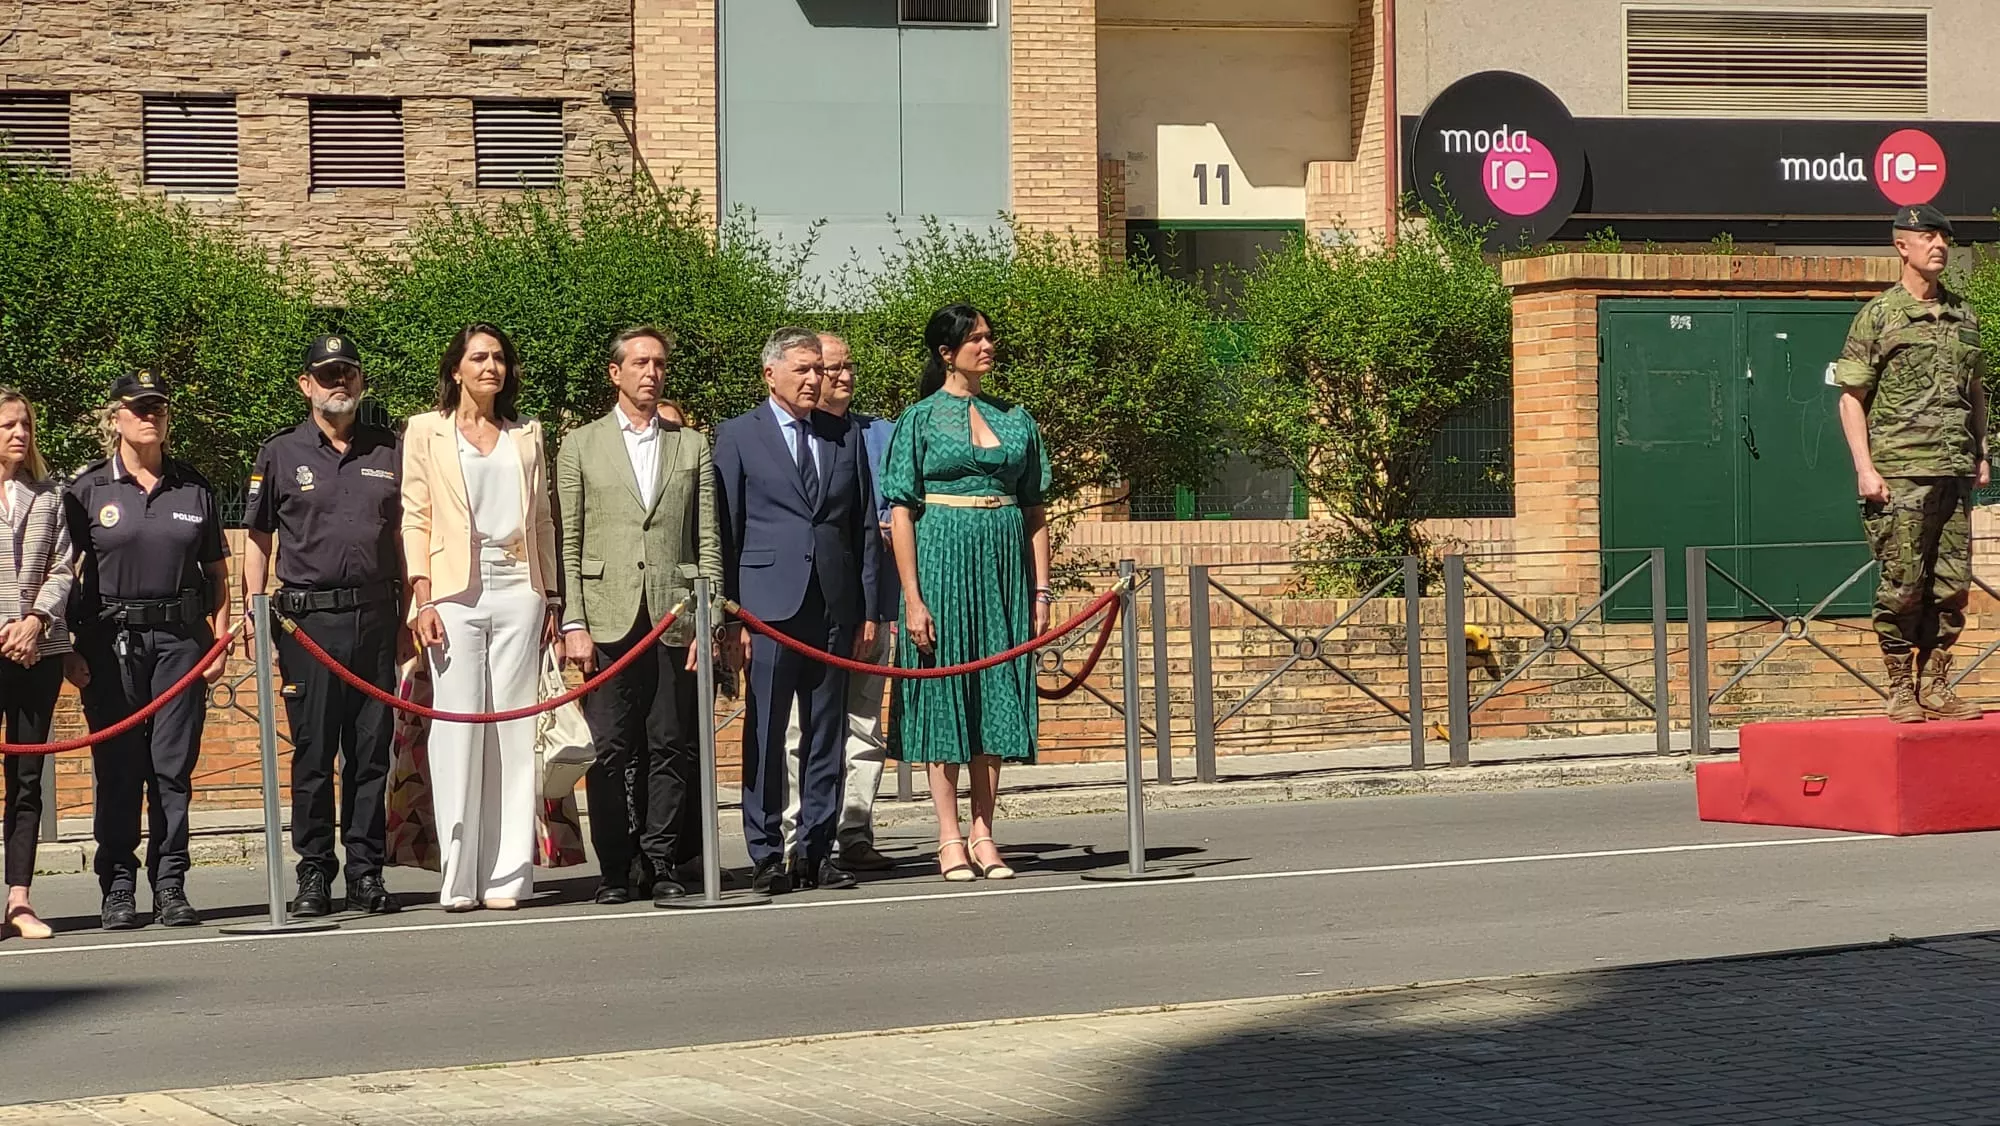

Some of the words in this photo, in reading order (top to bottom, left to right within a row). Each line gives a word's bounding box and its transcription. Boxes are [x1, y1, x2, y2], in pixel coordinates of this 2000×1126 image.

[1440, 123, 1532, 153] moda
[1491, 160, 1549, 190] re-
[1781, 152, 1868, 181] moda
[1882, 152, 1938, 182] re-
[1193, 164, 1230, 205] 11
